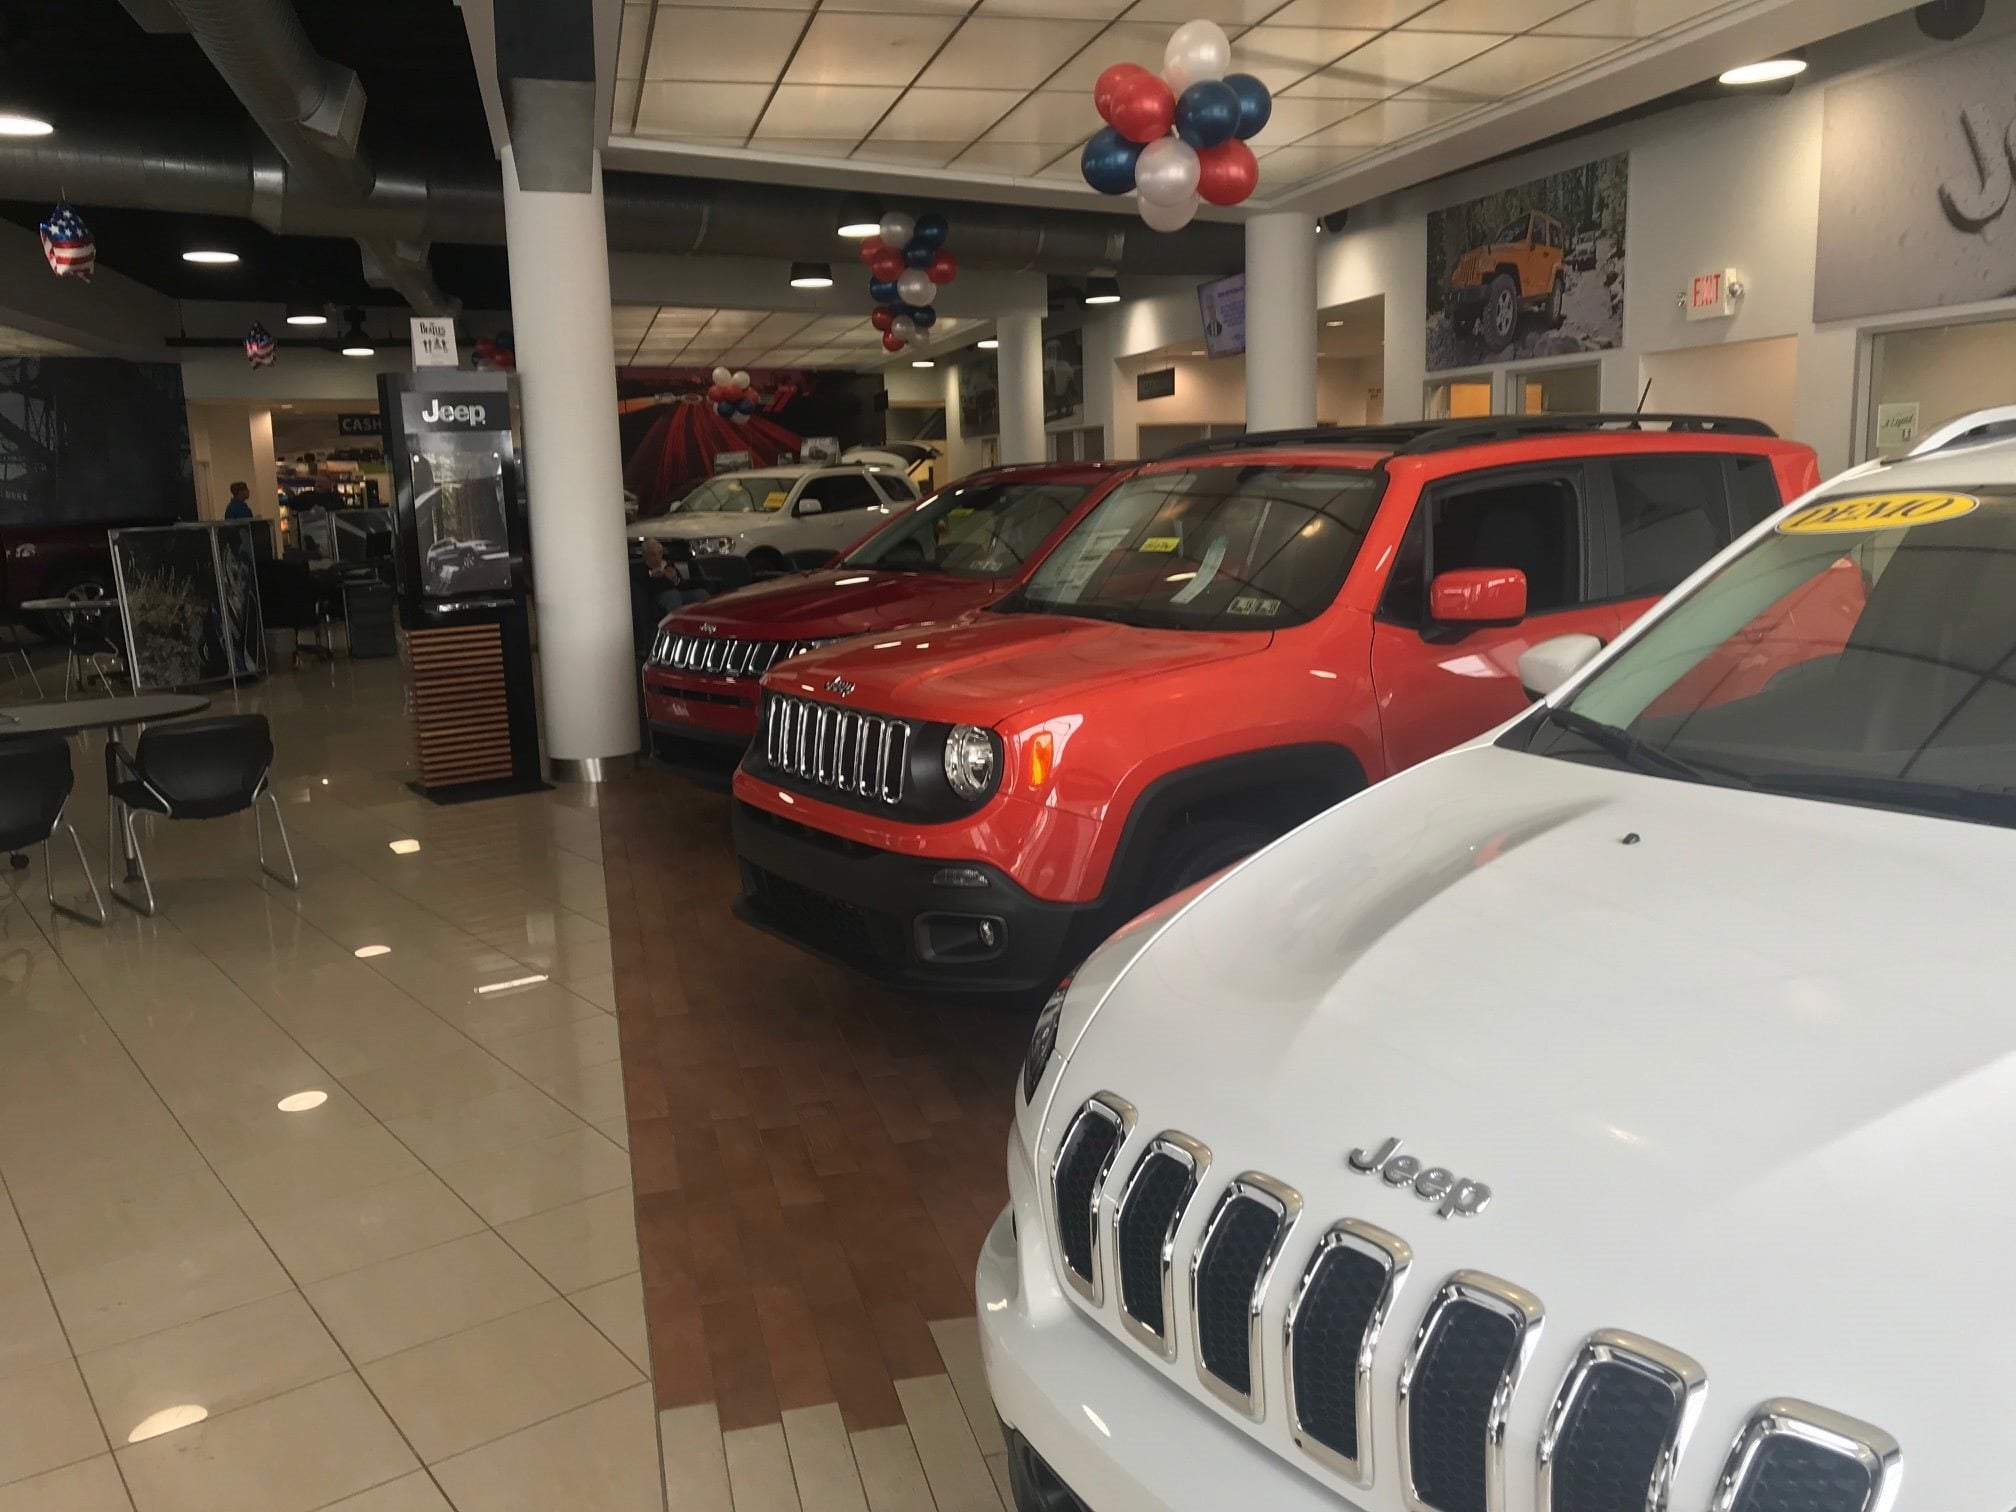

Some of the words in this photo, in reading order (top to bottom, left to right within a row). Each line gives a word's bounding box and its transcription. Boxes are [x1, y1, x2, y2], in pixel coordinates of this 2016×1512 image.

[1693, 273, 1721, 308] EXIT
[422, 399, 485, 427] Jeep
[1790, 498, 1954, 527] DEMO
[1348, 1136, 1491, 1220] Jeep
